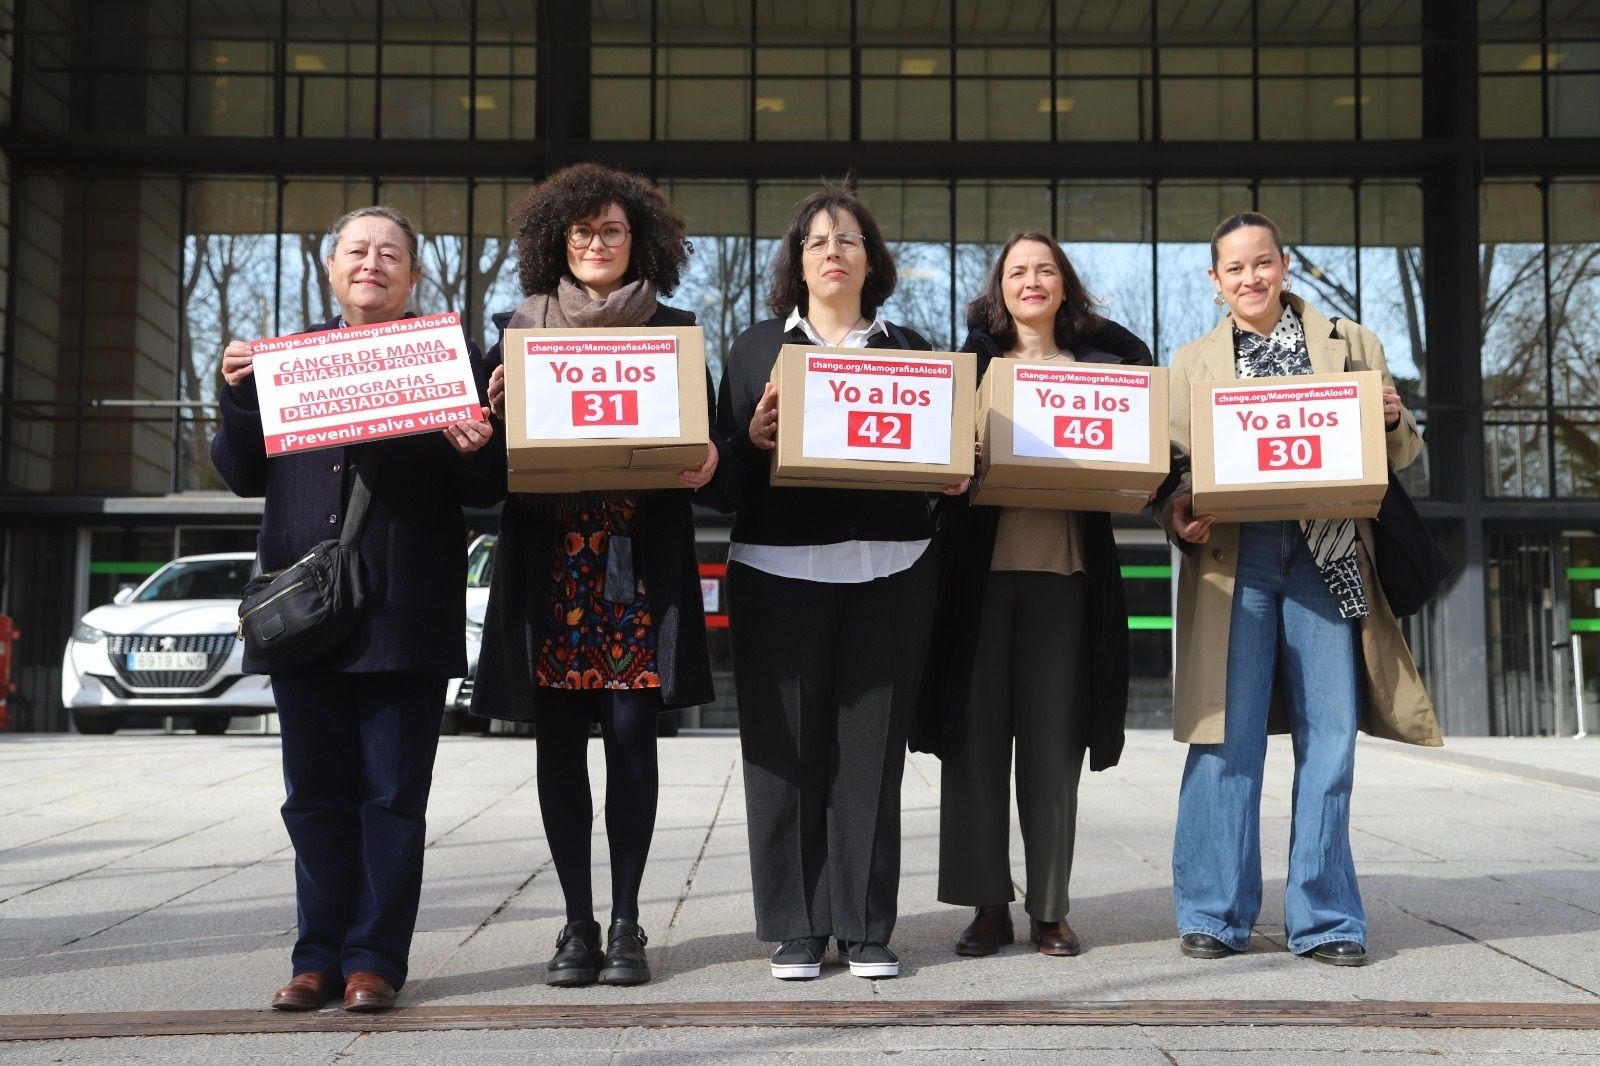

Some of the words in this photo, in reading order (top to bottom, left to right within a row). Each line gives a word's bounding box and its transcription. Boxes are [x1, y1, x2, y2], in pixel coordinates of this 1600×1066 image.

[253, 315, 456, 352] change.org/MamografiasAlos40
[280, 354, 354, 373] CÁNCER
[358, 348, 381, 362] DE
[387, 339, 445, 357] MAMA
[532, 343, 671, 353] change.org/MamografiasAlos40
[280, 361, 380, 386] DEMASIADO
[384, 351, 450, 369] PRONTO
[550, 361, 584, 383] Yo
[592, 366, 606, 383] a
[616, 361, 656, 383] los
[813, 361, 948, 375] change.org/MamografiasAlos40
[1020, 371, 1144, 385] change.org/MamografiasAlos40
[284, 393, 400, 421] DEMASIADO
[402, 383, 463, 403] TARDE
[299, 373, 435, 404] MAMOGRAFÍAS
[829, 380, 861, 403] Yo
[869, 387, 883, 404] a
[893, 382, 931, 407] los
[1036, 388, 1065, 409] Yo
[1072, 395, 1086, 410] a
[1094, 391, 1130, 412] los
[1219, 389, 1353, 403] change.org/MamografiasAlos40
[584, 394, 623, 421] 31
[1236, 411, 1268, 431] Yo
[1276, 414, 1291, 429] a
[1300, 407, 1339, 428] los
[280, 425, 363, 451] ¡Prevenir
[368, 418, 415, 434] salva
[419, 407, 472, 426] vidas!
[858, 416, 902, 444] 42
[1063, 419, 1105, 446] 46
[1268, 439, 1313, 467] 30
